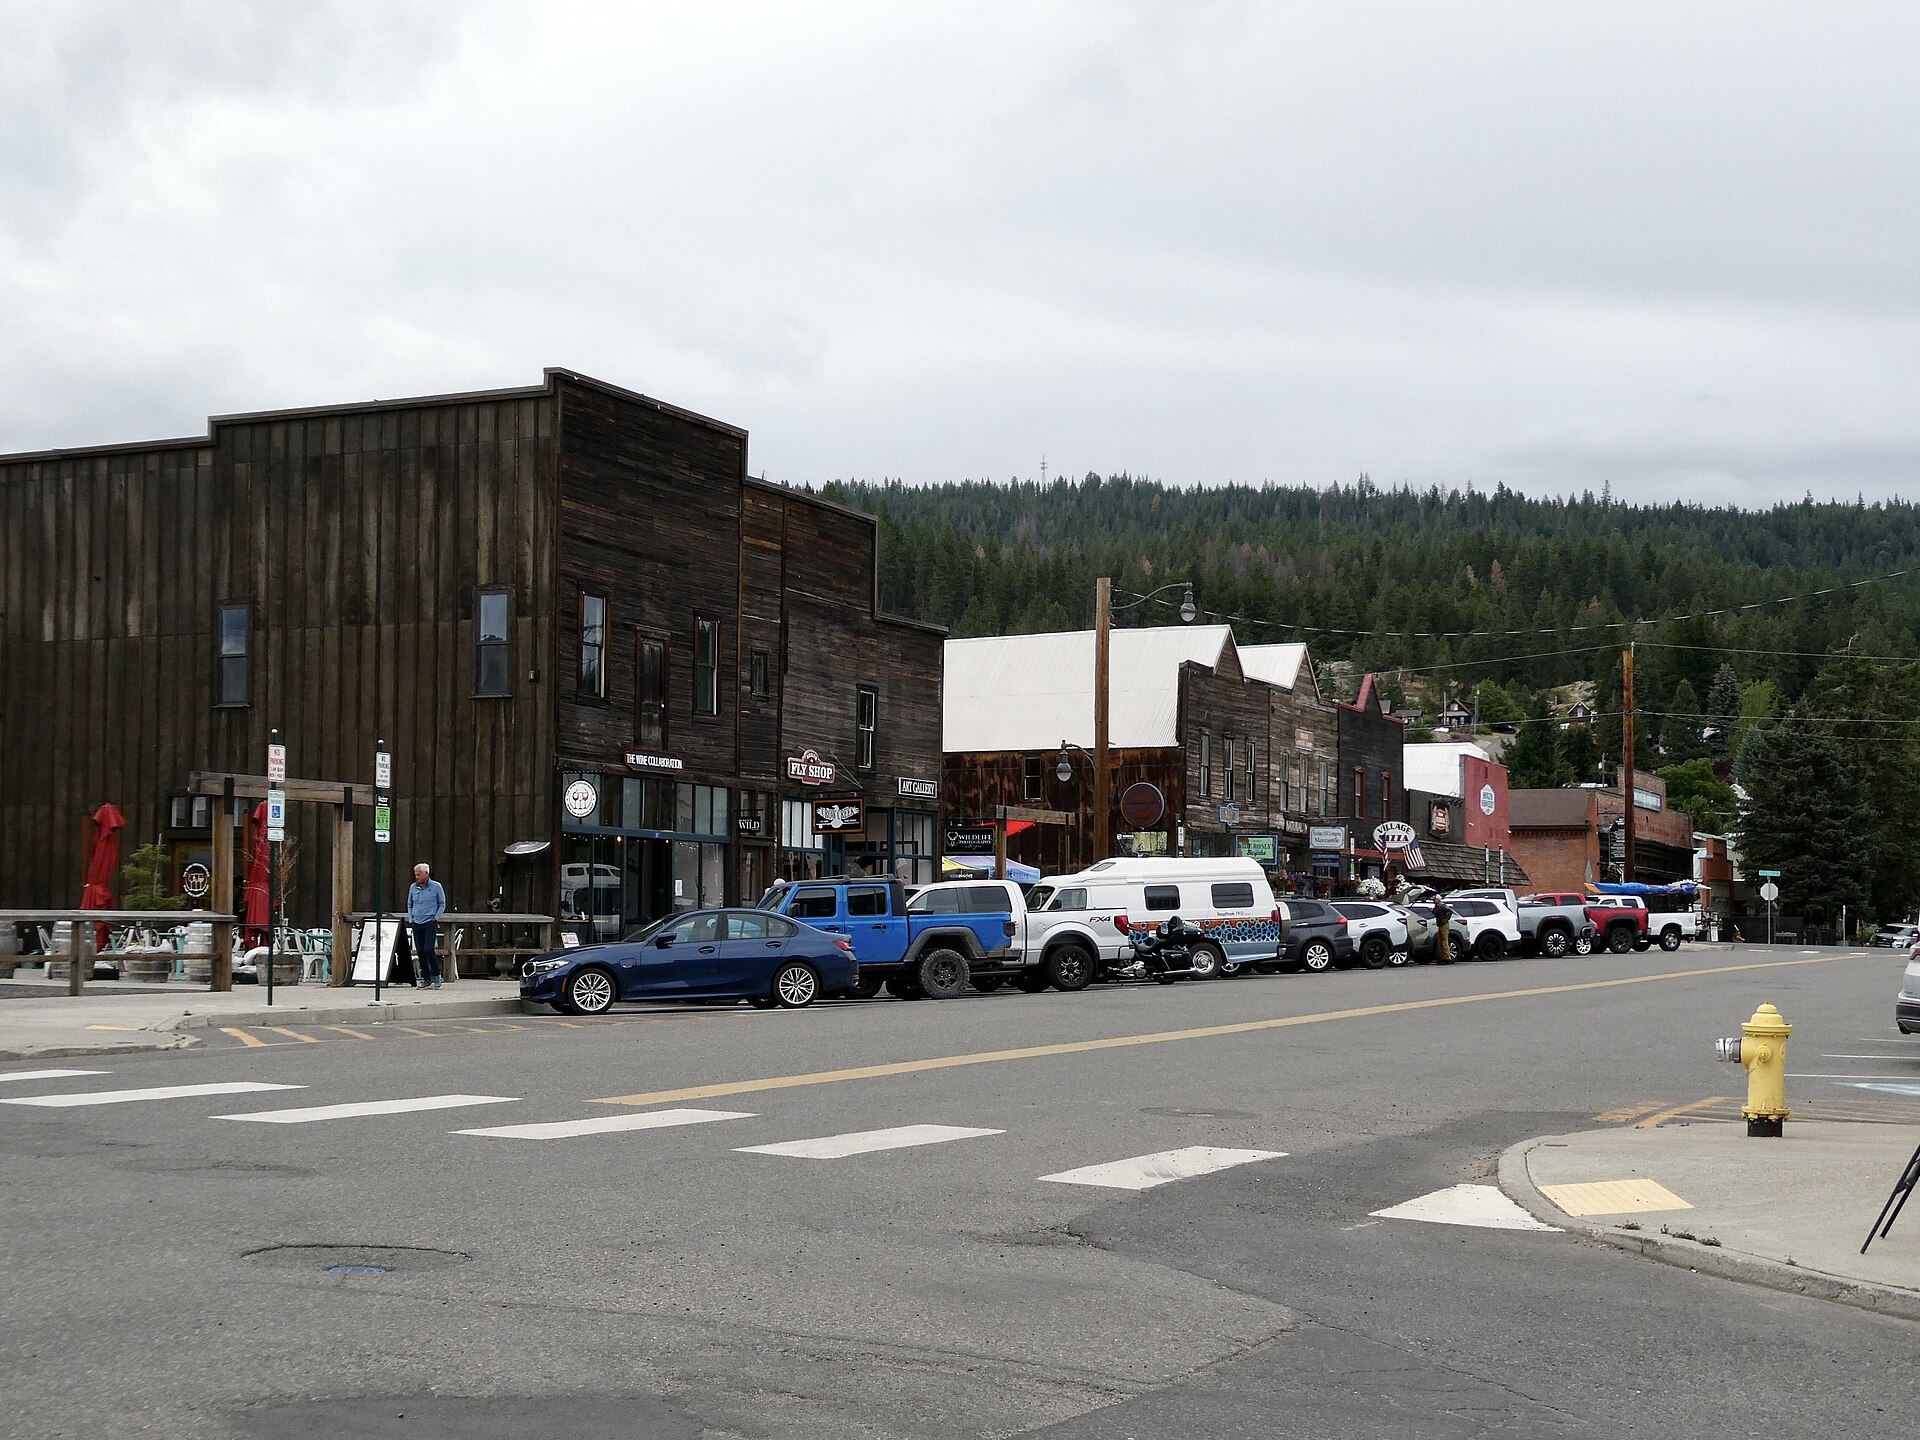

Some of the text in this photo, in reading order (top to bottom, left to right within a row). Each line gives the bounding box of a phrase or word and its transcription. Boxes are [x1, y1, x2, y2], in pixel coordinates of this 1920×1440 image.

[626, 753, 683, 769] THE WINE COLLABORATION
[790, 762, 832, 779] FLY SHOP
[902, 780, 935, 795] ART GALLERY
[738, 821, 760, 829] WILD
[1377, 823, 1411, 834] VILLAGE
[1314, 836, 1340, 844] Mercantile
